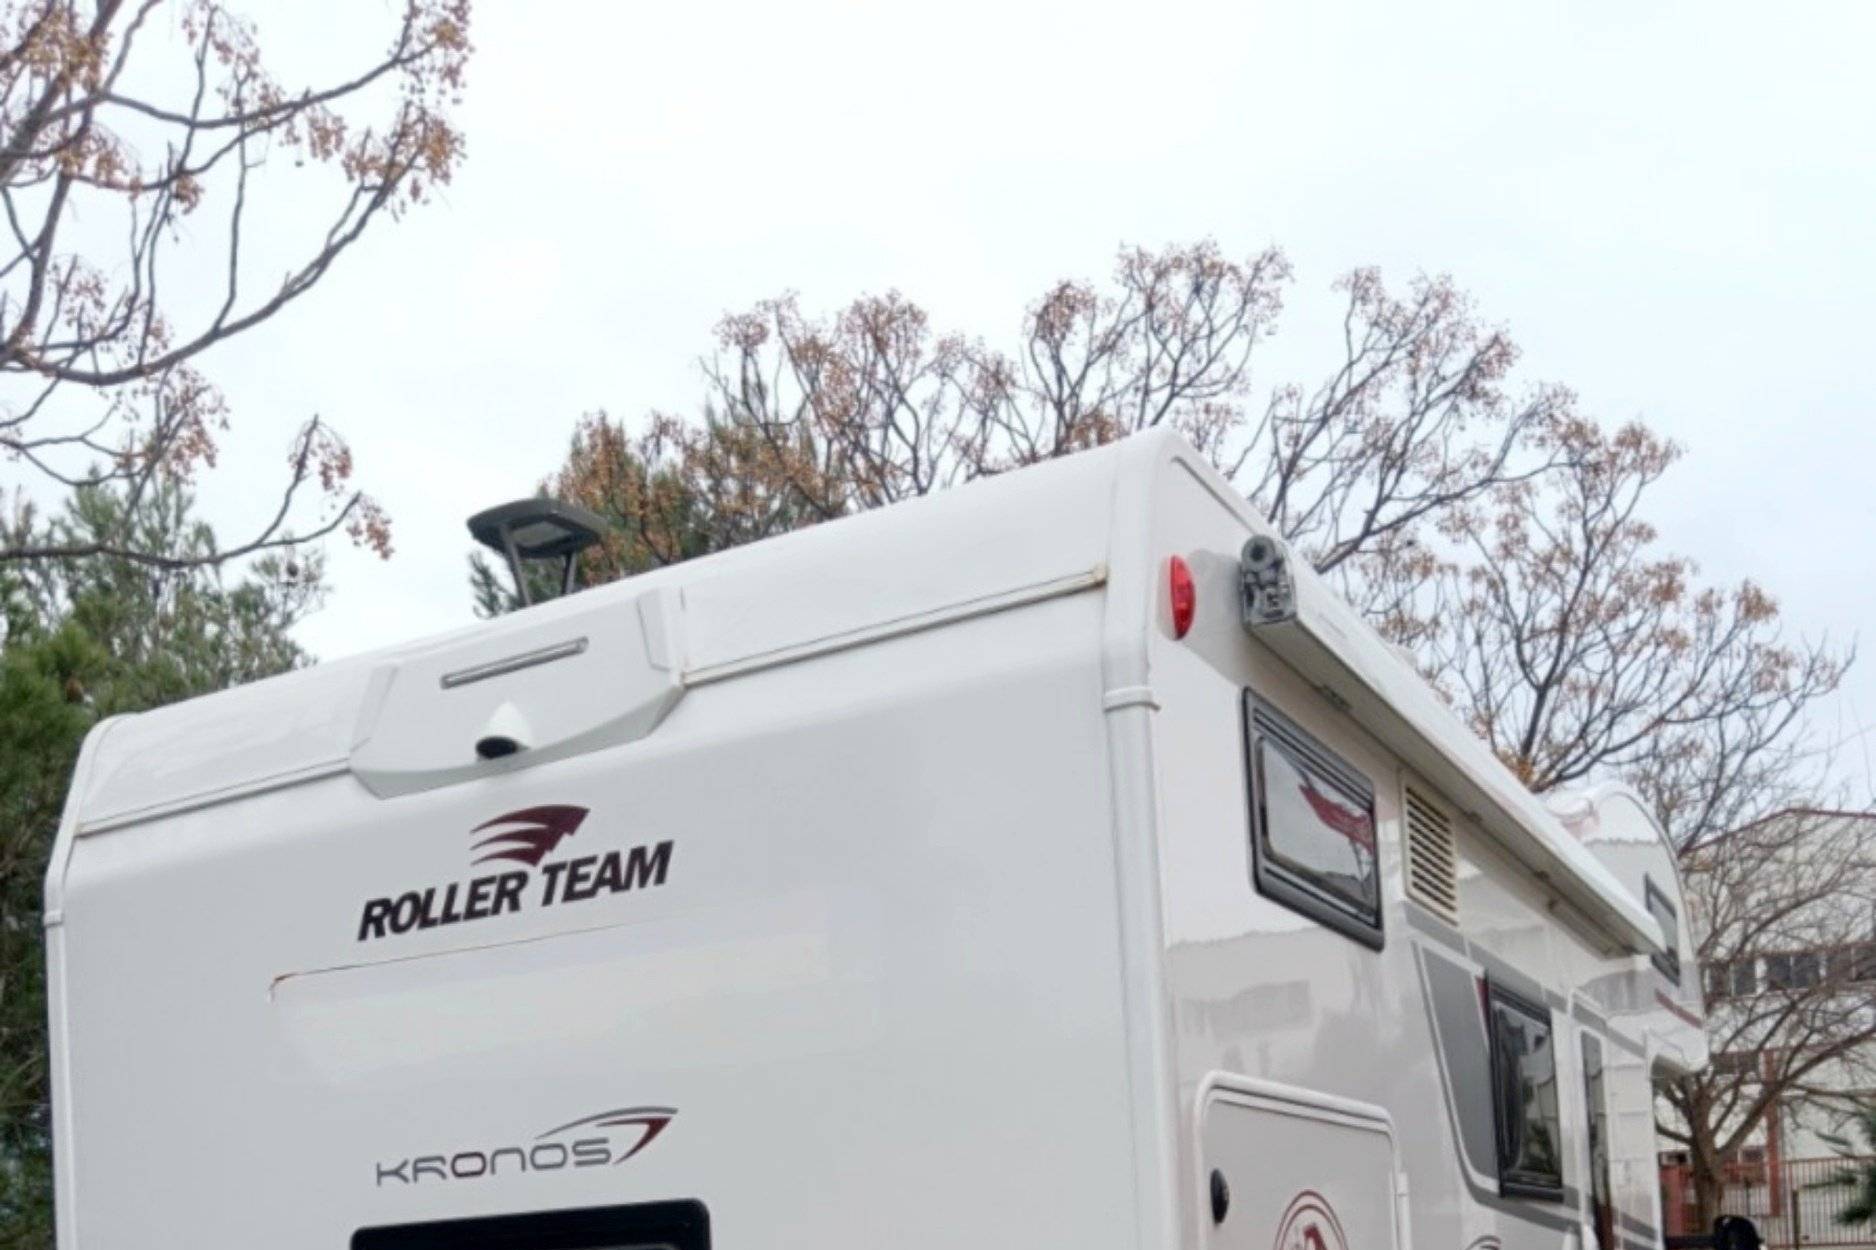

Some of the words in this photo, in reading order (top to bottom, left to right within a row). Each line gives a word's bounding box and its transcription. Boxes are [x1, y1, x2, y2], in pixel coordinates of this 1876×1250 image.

[357, 870, 529, 941] ROLLER
[541, 840, 674, 907] TEAM
[376, 1137, 612, 1187] KRONOS
